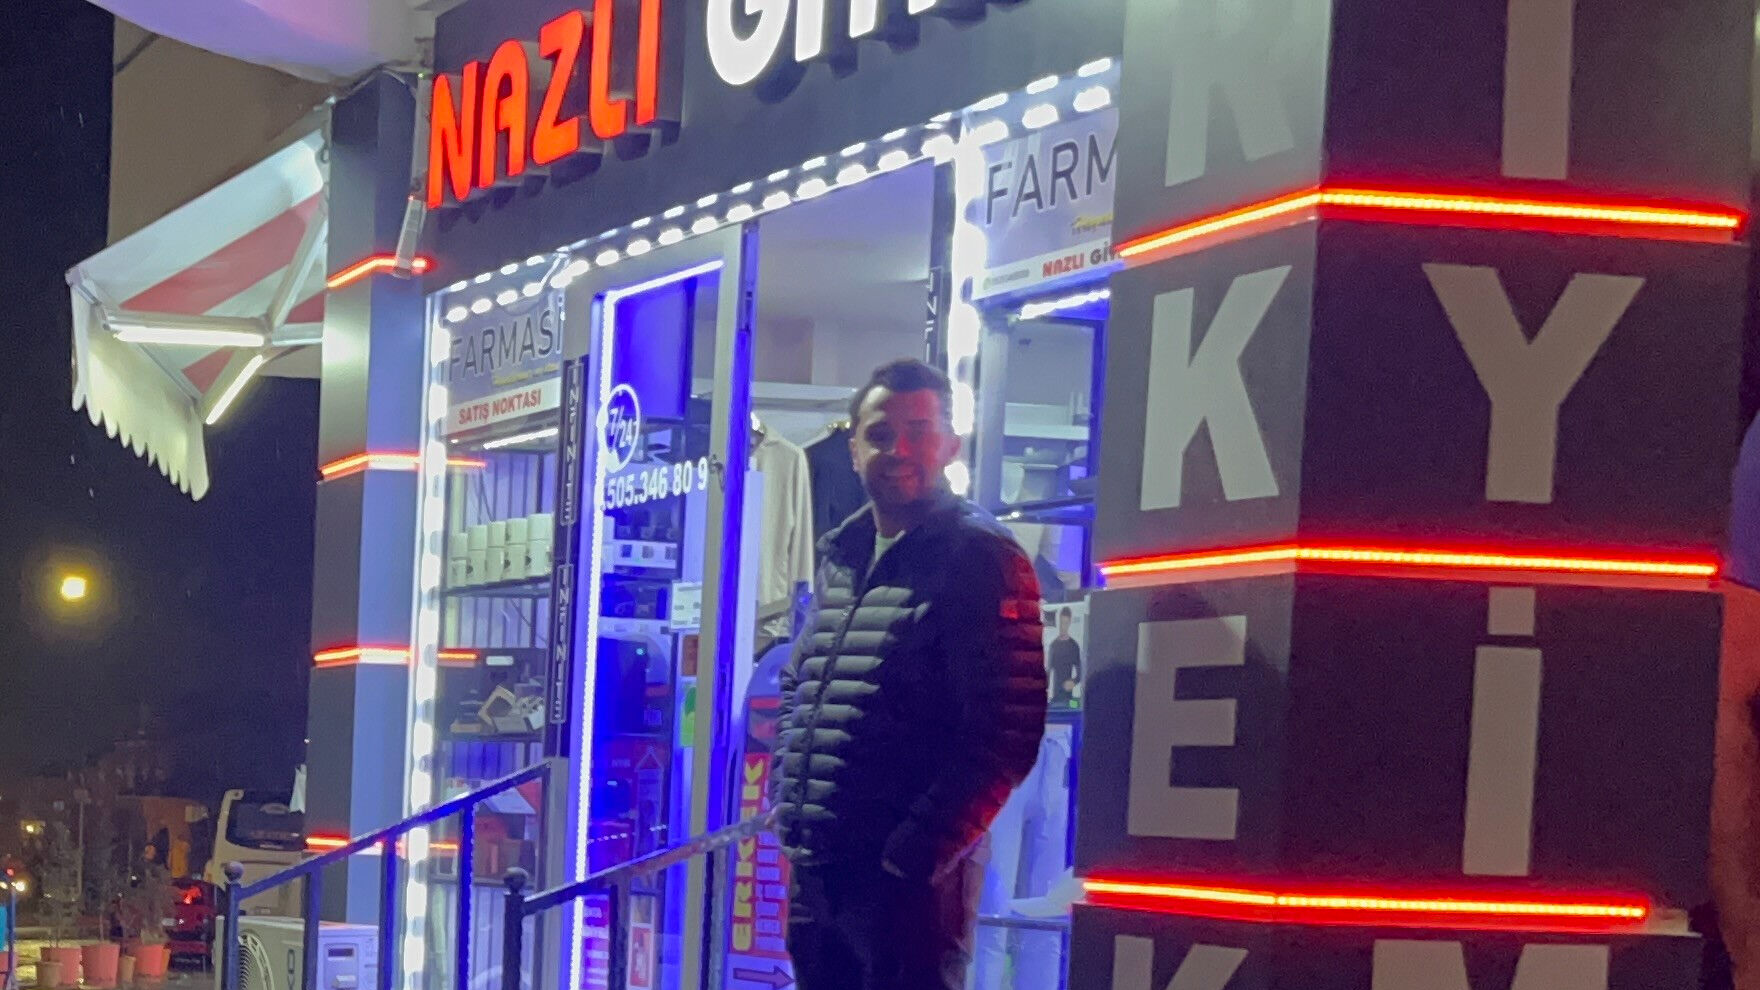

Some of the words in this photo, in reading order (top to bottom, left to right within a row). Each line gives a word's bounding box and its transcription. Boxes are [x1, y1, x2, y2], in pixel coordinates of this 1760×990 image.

[427, 0, 661, 210] NAZLI
[1042, 253, 1085, 278] NAZLI
[458, 401, 490, 425] SATIŞ
[492, 388, 542, 417] NOKTASI
[672, 460, 693, 496] 80
